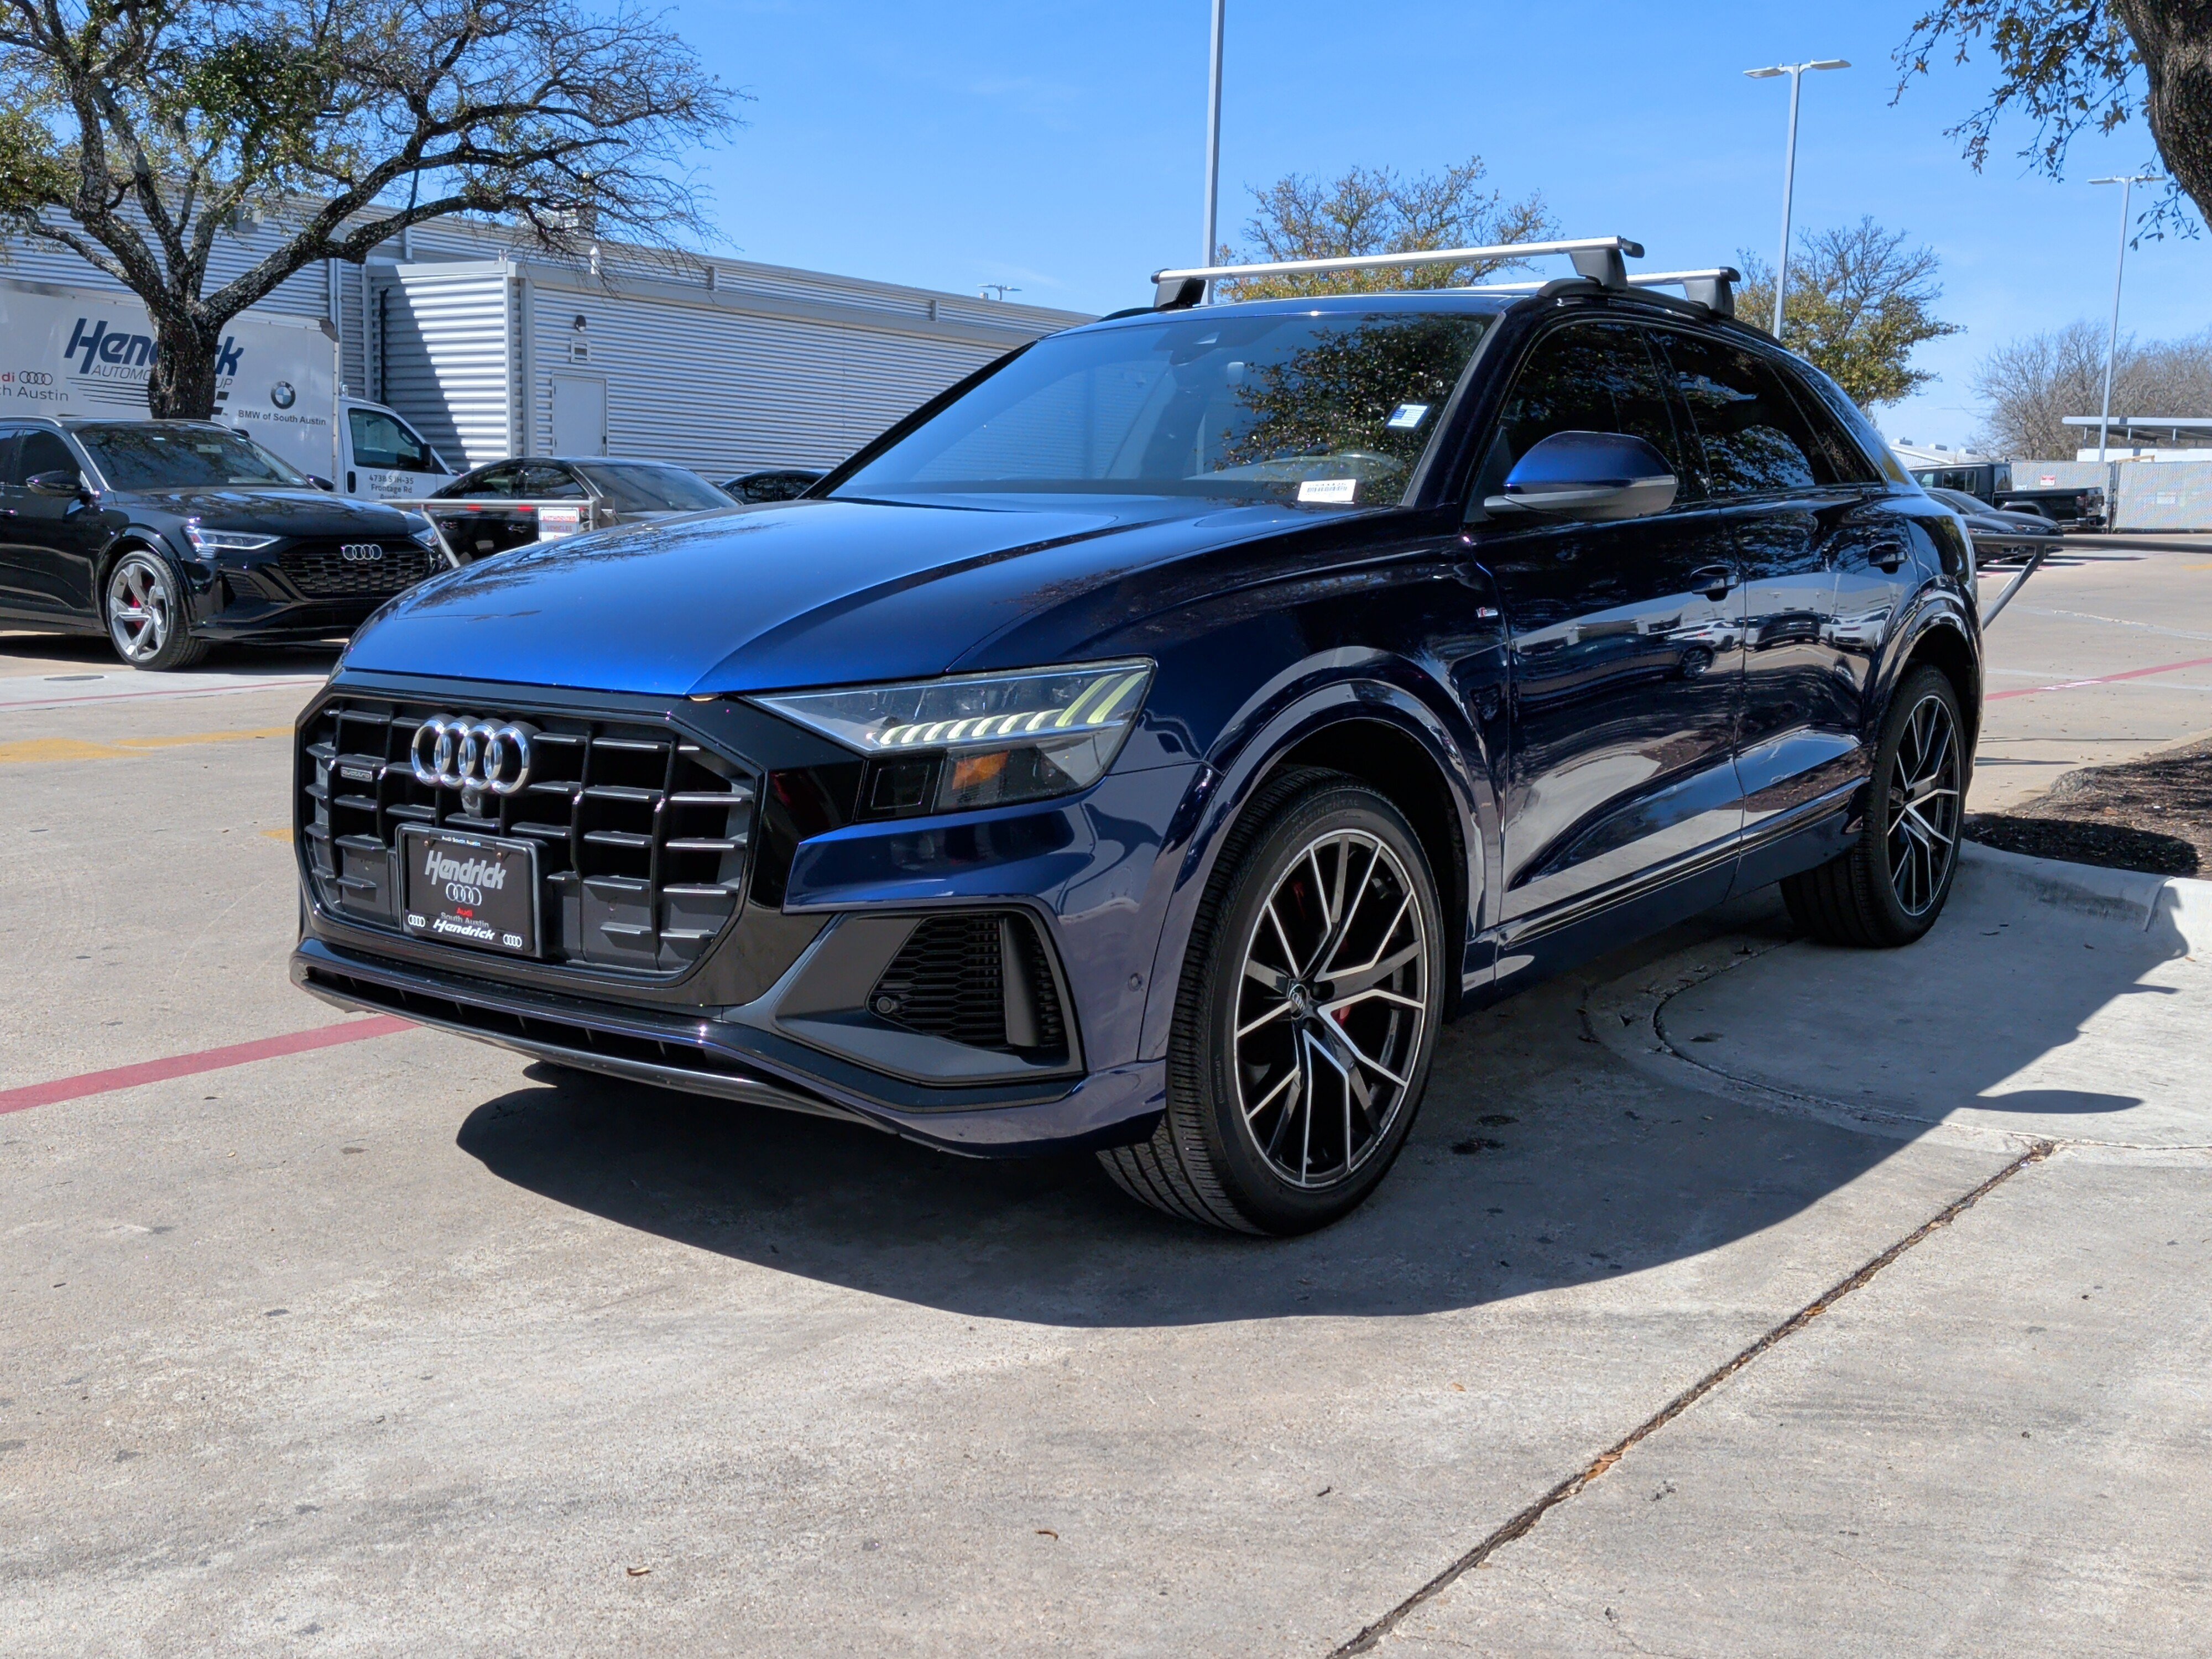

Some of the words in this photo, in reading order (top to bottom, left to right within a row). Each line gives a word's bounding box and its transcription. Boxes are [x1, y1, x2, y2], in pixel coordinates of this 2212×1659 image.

[64, 318, 244, 376] Henk
[2, 372, 14, 382] di
[17, 387, 69, 401] Austin
[238, 410, 260, 419] BMW
[274, 414, 298, 424] South
[299, 416, 326, 425] Austin
[371, 484, 401, 494] Frontage
[425, 850, 506, 889] Hendrick
[457, 907, 473, 917] Audi
[441, 912, 463, 924] South
[465, 917, 489, 928] Austin
[433, 919, 495, 940] Hendrick
